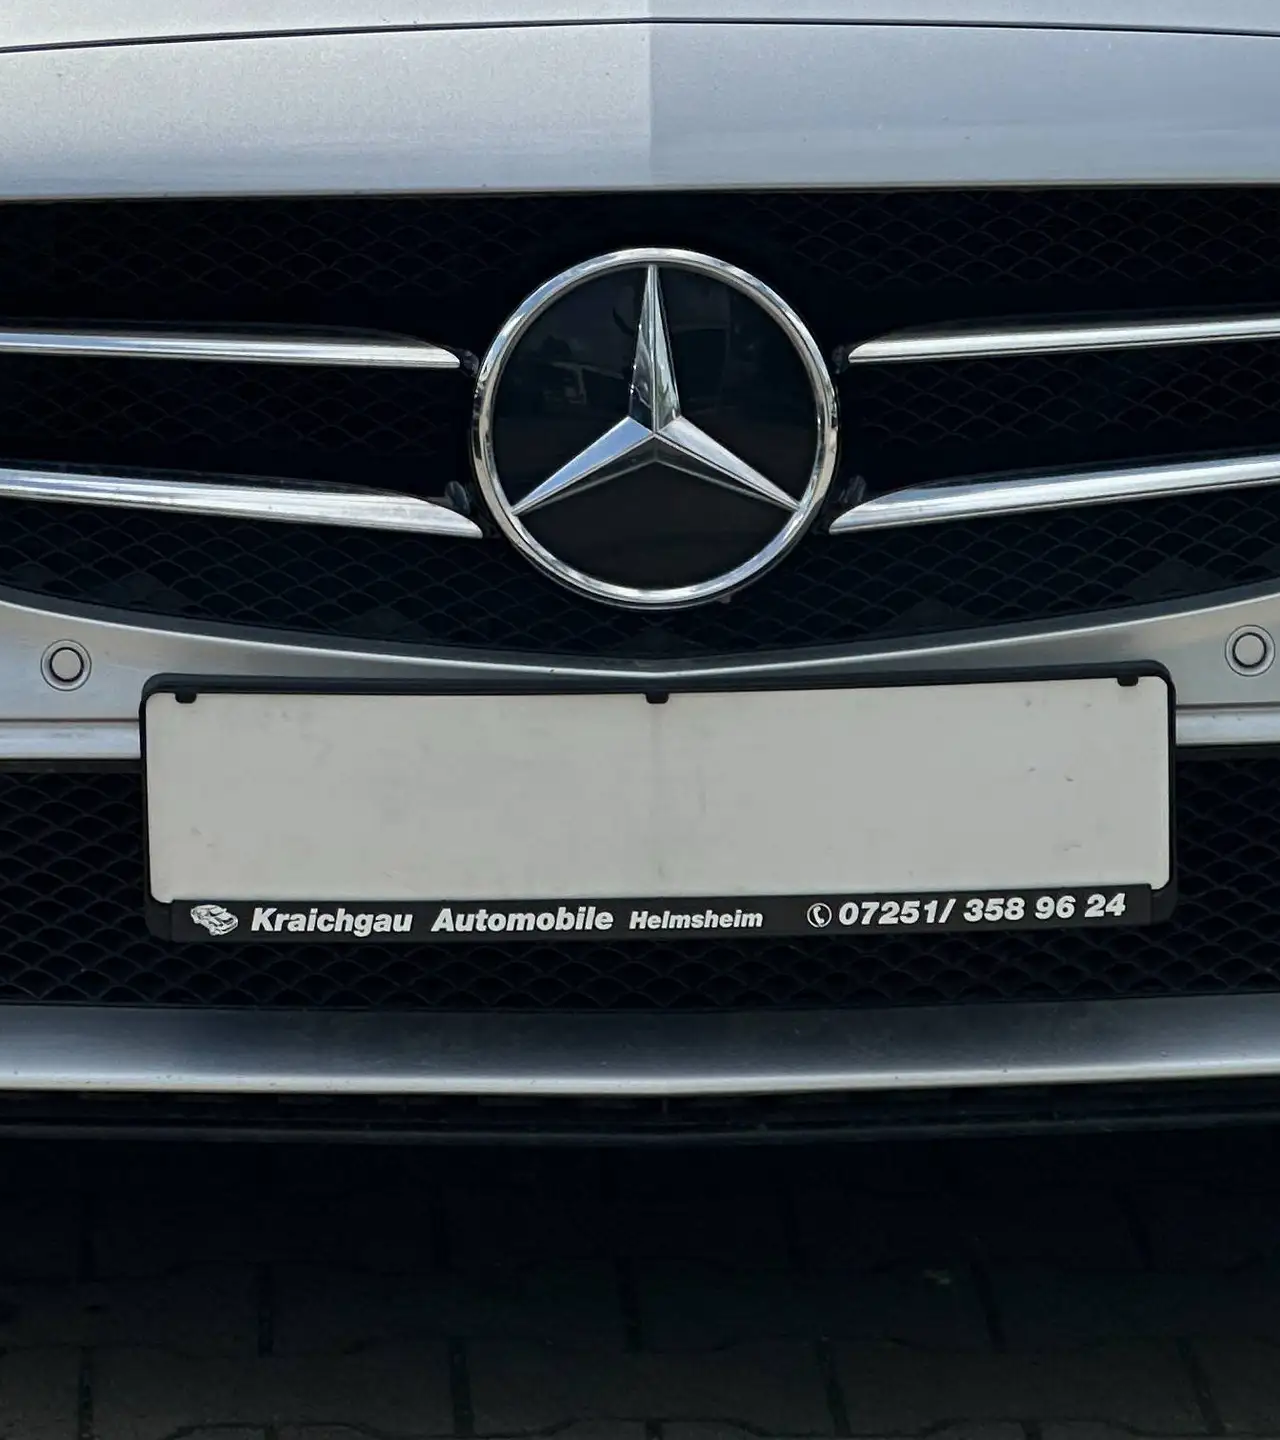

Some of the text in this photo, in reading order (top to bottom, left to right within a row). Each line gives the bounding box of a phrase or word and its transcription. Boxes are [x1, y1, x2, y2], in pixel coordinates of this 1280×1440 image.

[250, 893, 1126, 938] Kraichgau Automobile Helmsheim 07251/ 358 96 24
